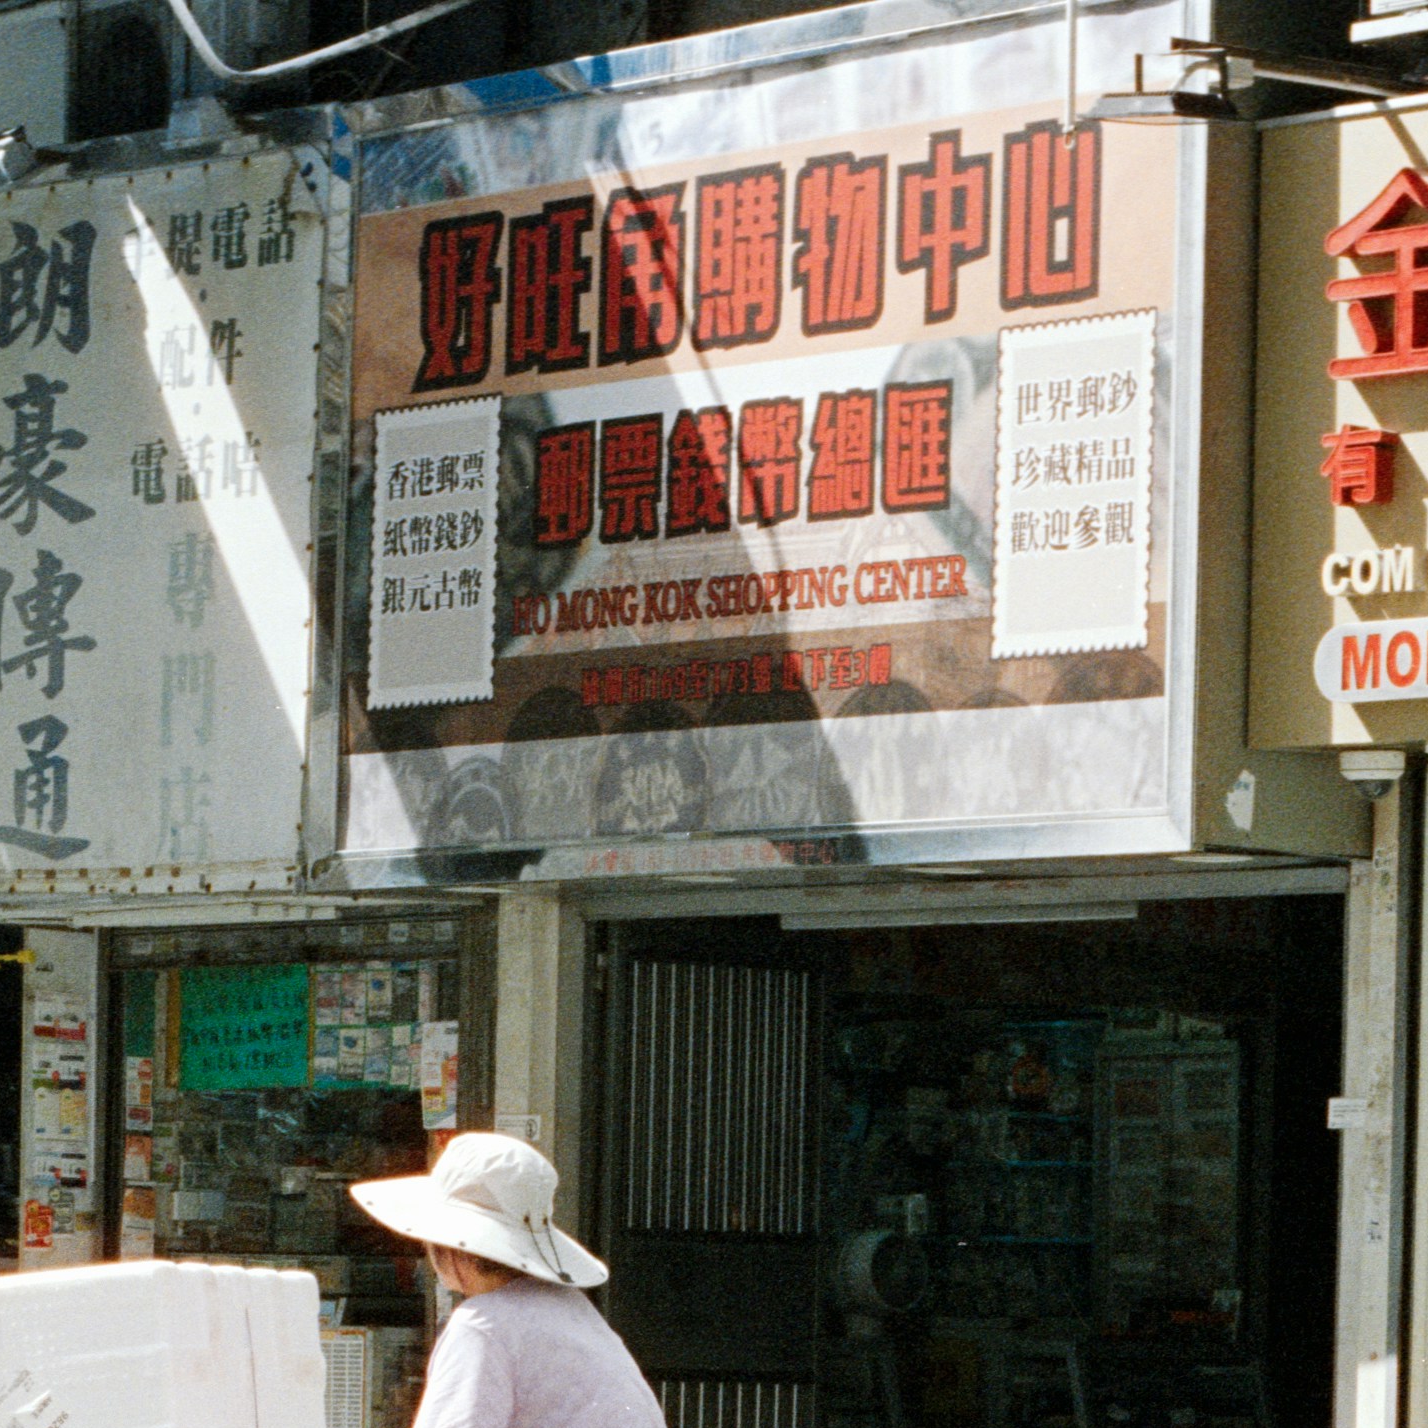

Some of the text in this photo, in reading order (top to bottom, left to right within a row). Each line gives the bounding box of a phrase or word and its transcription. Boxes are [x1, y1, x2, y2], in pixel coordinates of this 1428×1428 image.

[412, 119, 1103, 392] 好旺角購物中心
[1016, 370, 1138, 425] 世界郵鈔
[386, 450, 485, 500] 香港郵票
[534, 381, 955, 546] 郵票錢幣總匯
[1012, 437, 1135, 490] 珍藏精品
[383, 509, 485, 557] 紙幣錢鈔
[1011, 501, 1135, 555] 歡迎參觀
[381, 568, 483, 615] 銀元古幣
[511, 554, 969, 637] HO MONG KOK SHOPPING CENTER
[1321, 545, 1413, 596] COM
